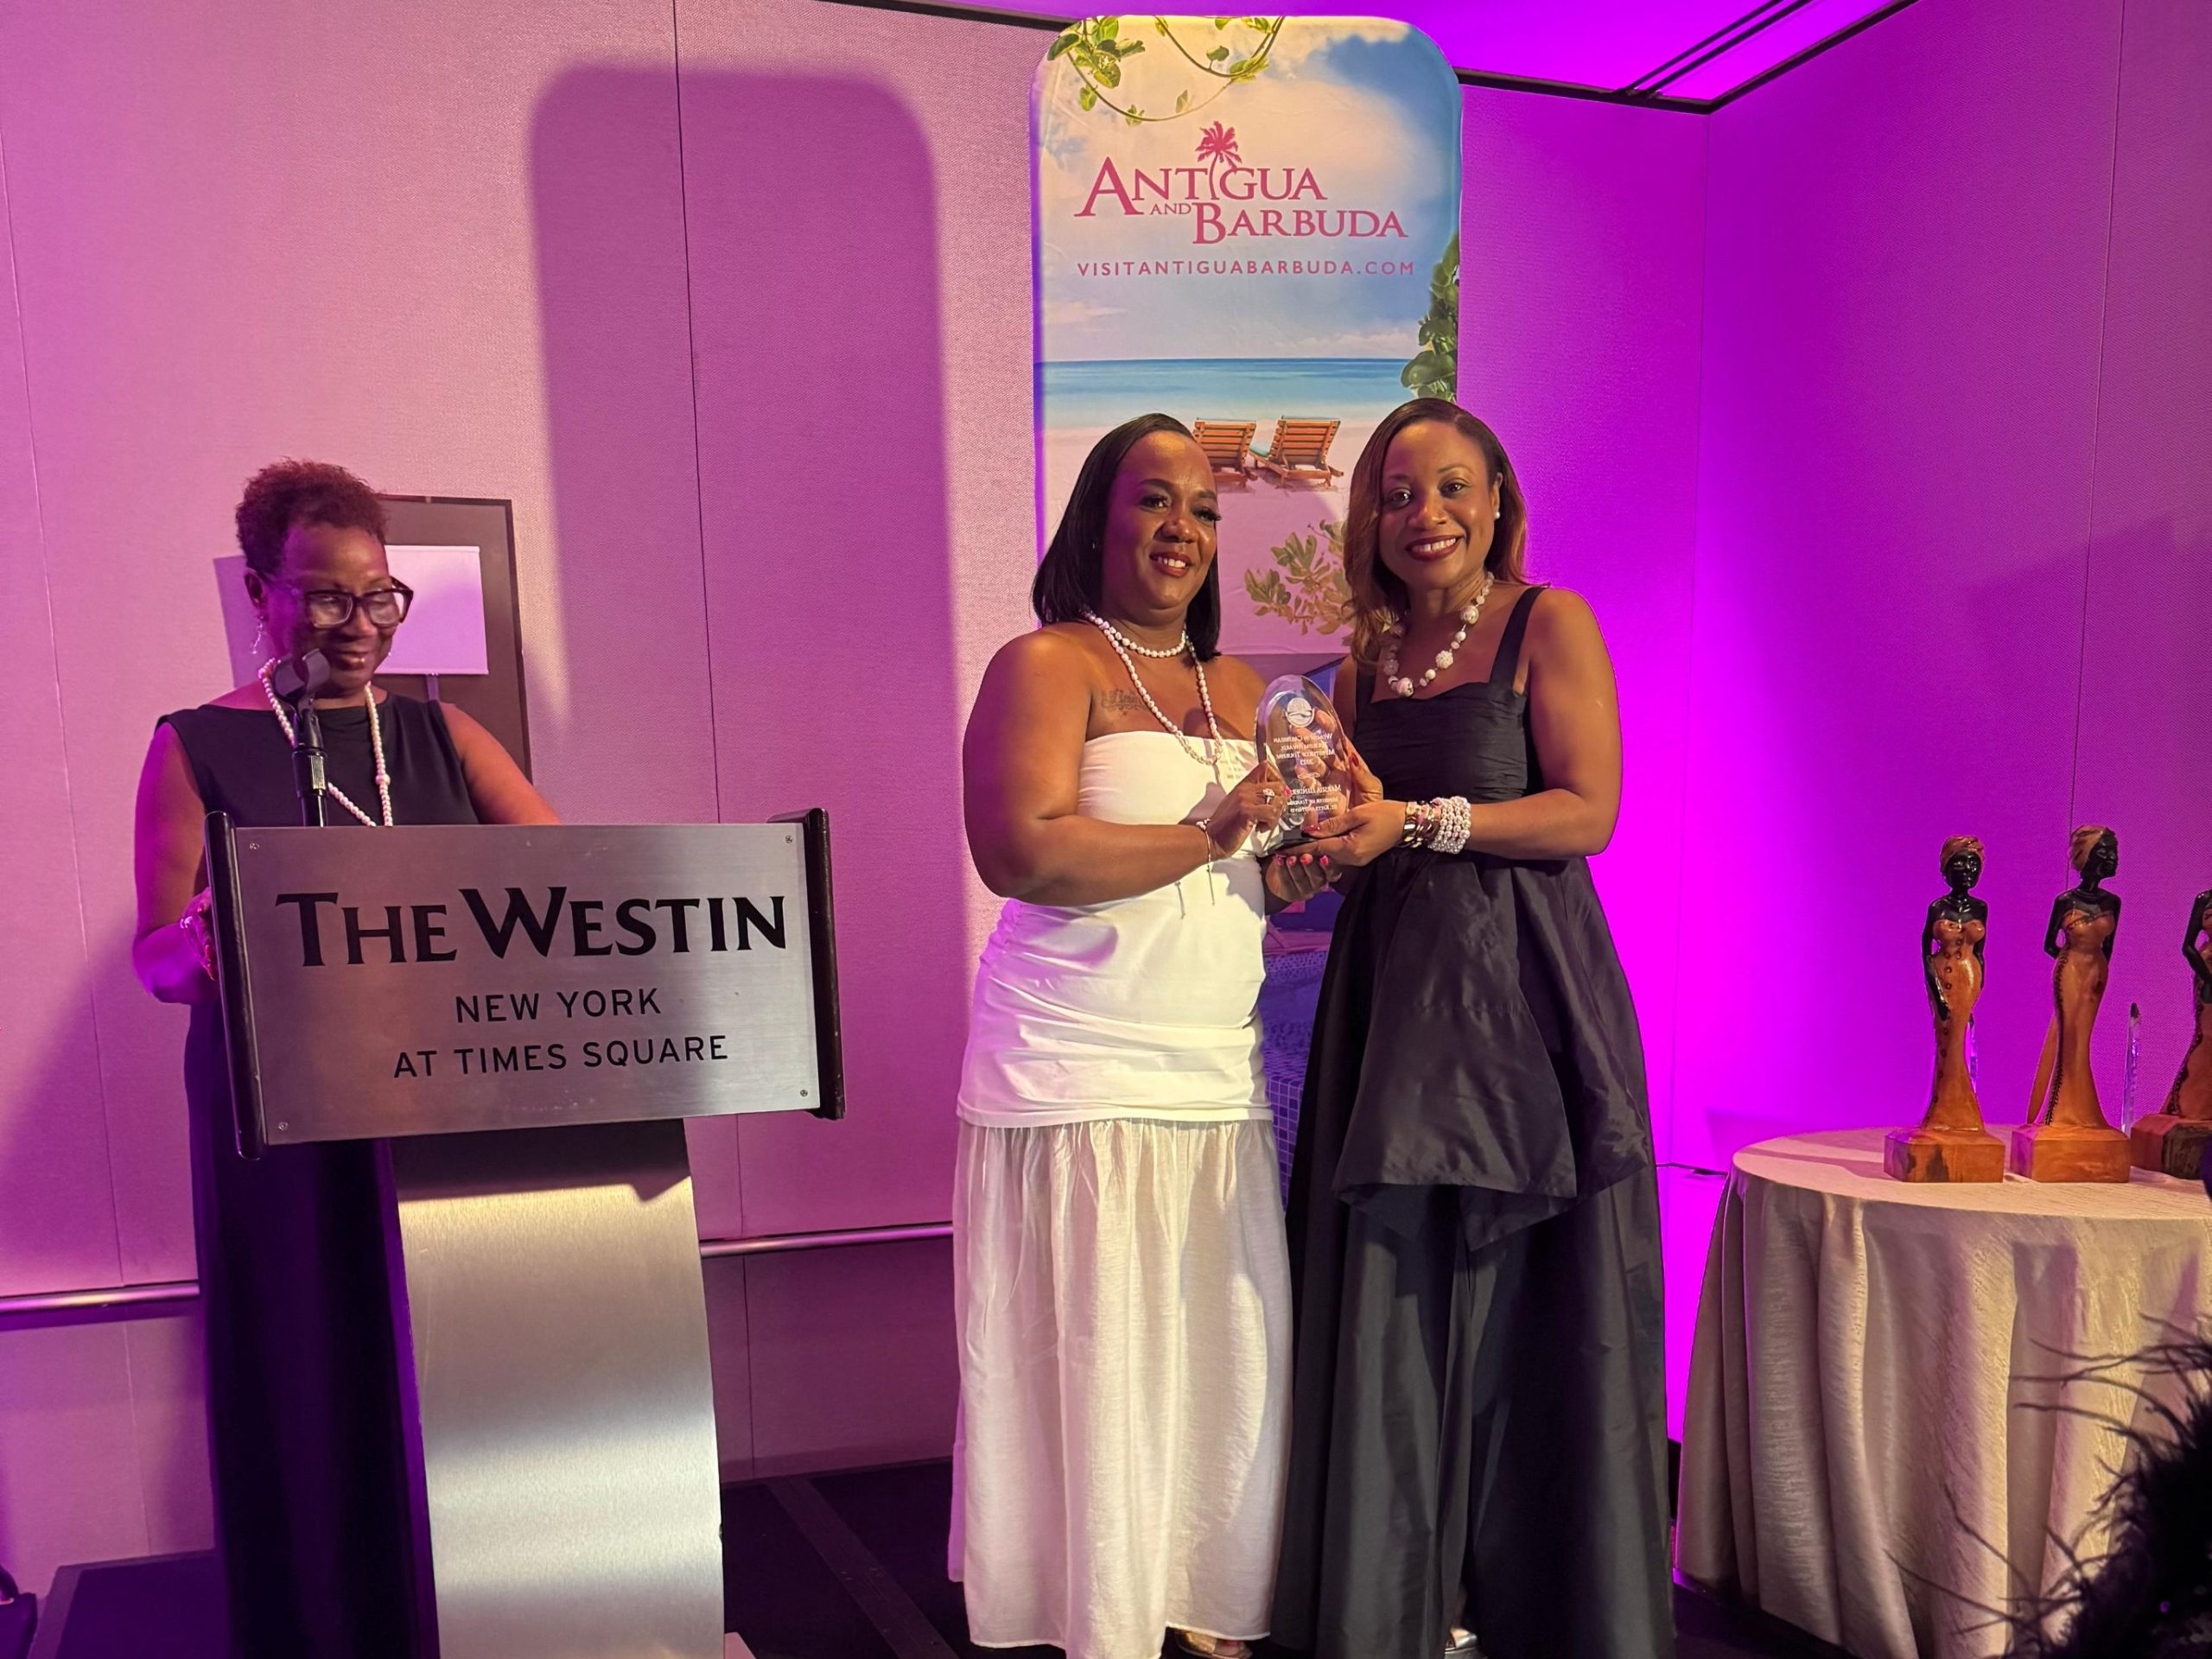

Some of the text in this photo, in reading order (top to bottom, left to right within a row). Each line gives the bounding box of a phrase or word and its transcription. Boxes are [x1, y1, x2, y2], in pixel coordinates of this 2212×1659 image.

[1073, 156, 1328, 218] ANTIGUA
[1149, 201, 1408, 245] AND BARBUDA
[1077, 260, 1414, 277] VISITANTIGUABARBUDA.COM
[275, 886, 787, 968] THE WESTIN
[455, 988, 662, 1024] NEW YORK
[393, 1035, 728, 1078] AT TIMES SQUARE
